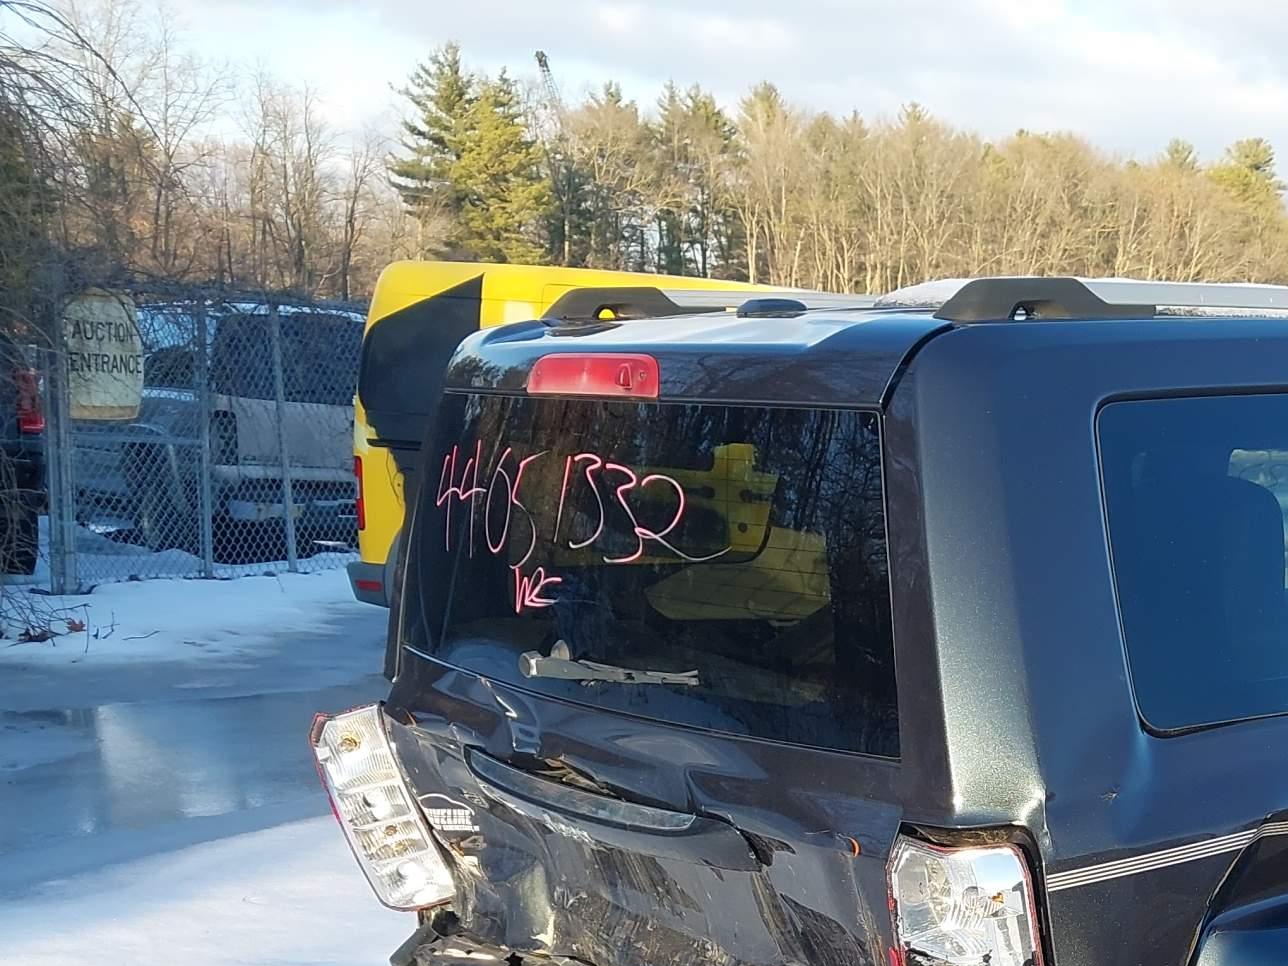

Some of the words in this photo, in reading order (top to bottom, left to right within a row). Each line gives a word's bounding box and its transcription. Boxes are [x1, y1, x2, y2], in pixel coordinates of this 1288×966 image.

[71, 320, 134, 343] AUCTION
[69, 352, 142, 375] ENTRANCE
[436, 439, 732, 569] 44051332
